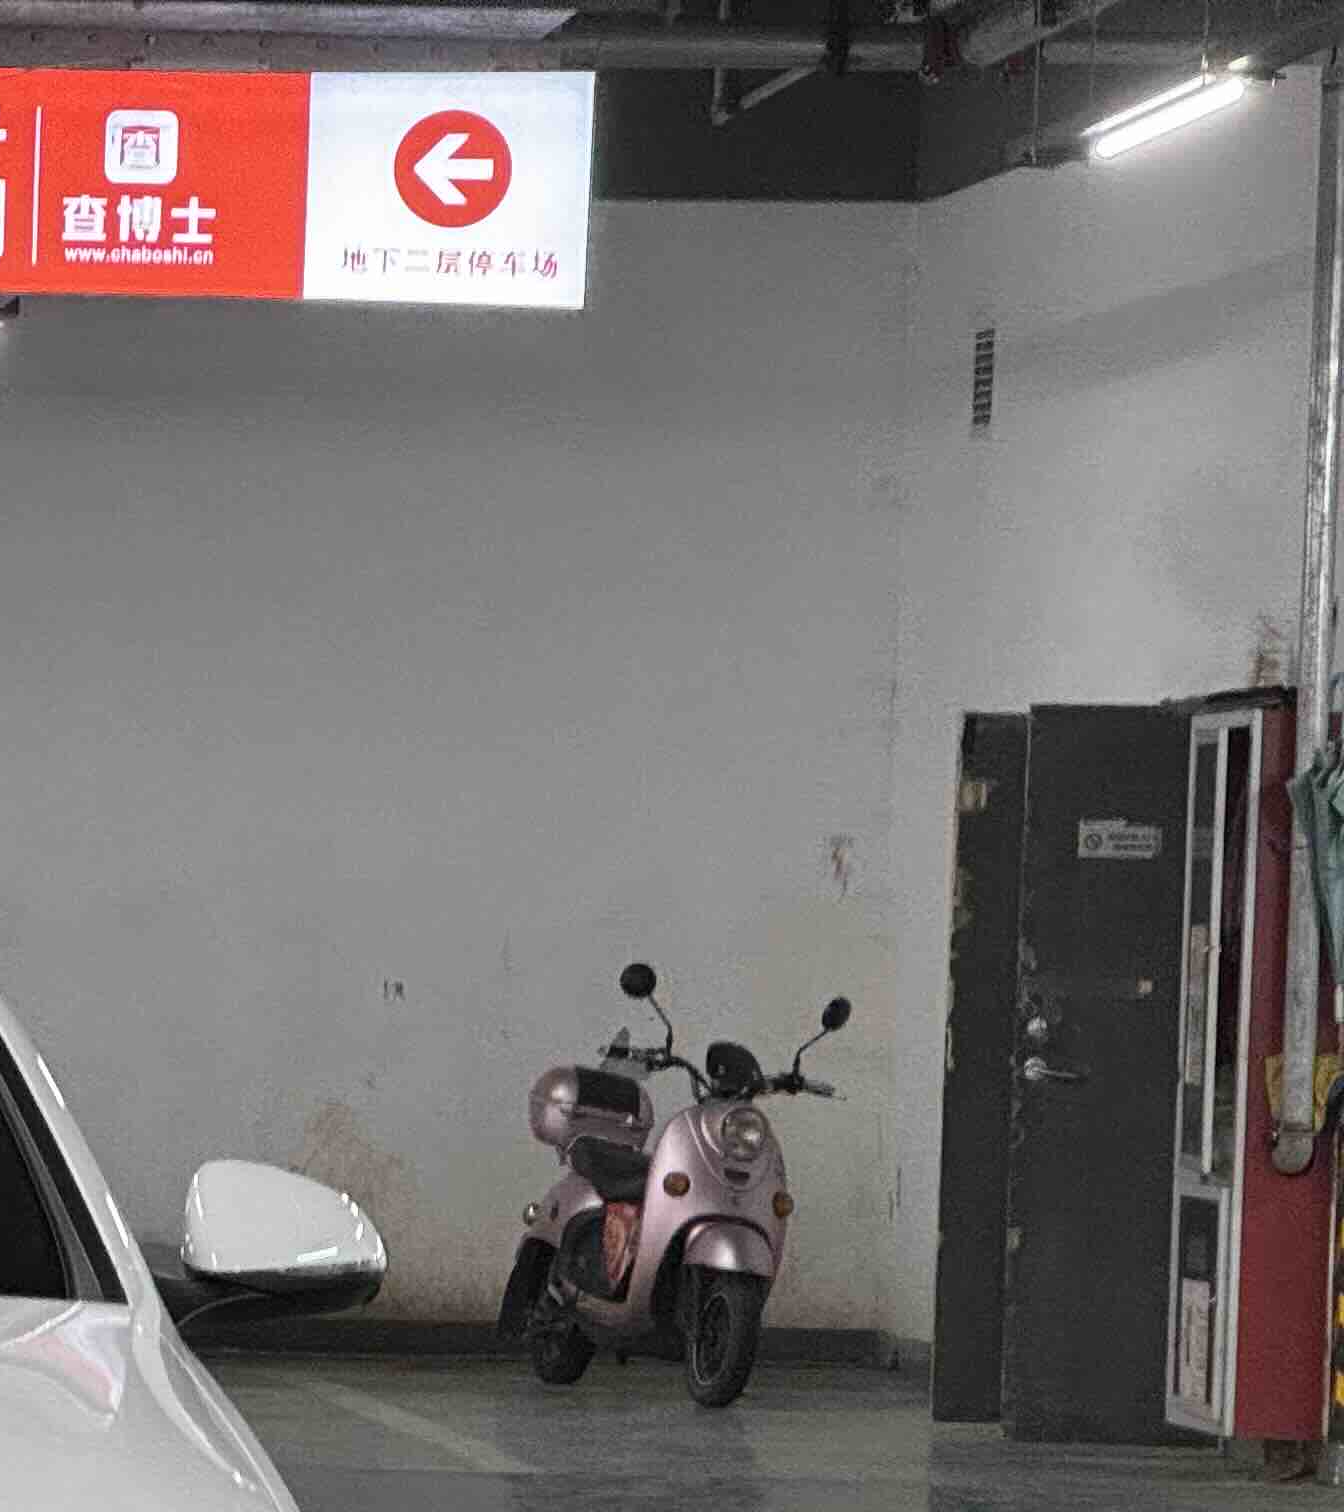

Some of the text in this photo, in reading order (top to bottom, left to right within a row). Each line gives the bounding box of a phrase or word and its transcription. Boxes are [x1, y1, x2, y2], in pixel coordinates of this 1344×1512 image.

[62, 193, 217, 244] 查博士
[64, 244, 215, 265] www.chaboshi.cn
[340, 245, 560, 279] 地下二层停车场
